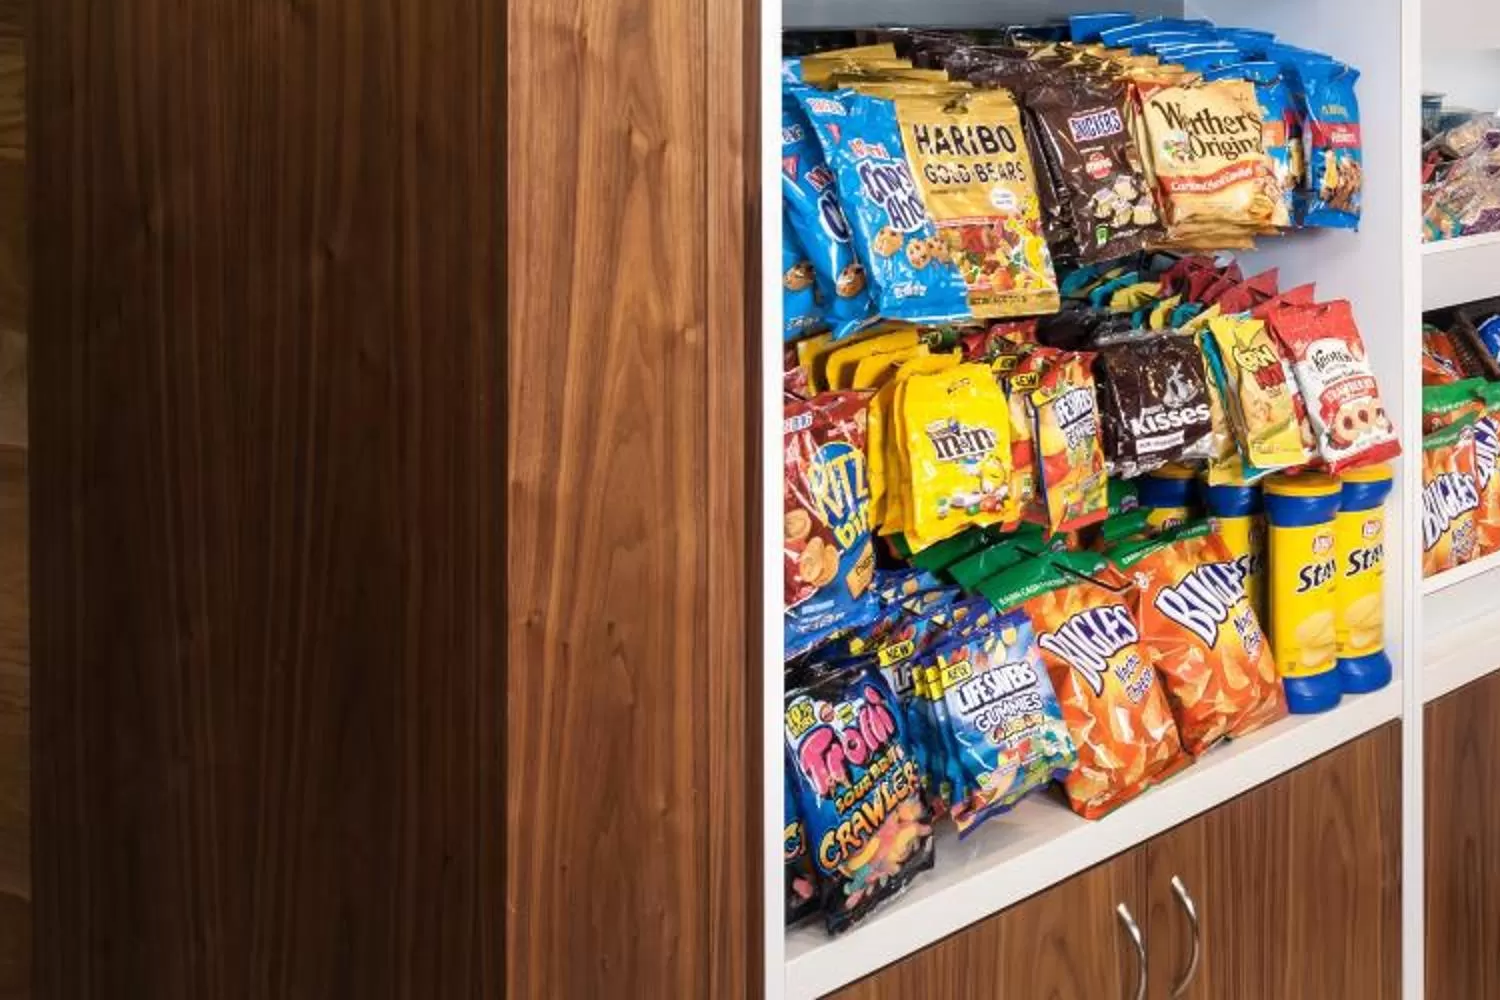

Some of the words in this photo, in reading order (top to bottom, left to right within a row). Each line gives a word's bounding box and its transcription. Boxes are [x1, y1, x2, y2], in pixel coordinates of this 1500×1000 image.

[913, 123, 1017, 156] HARIBO
[1151, 99, 1263, 136] Werther's
[1038, 604, 1140, 698] BUGLES
[800, 684, 896, 796] Trolli
[974, 693, 1043, 733] GUMMIES
[818, 759, 918, 870] CRAWLER
